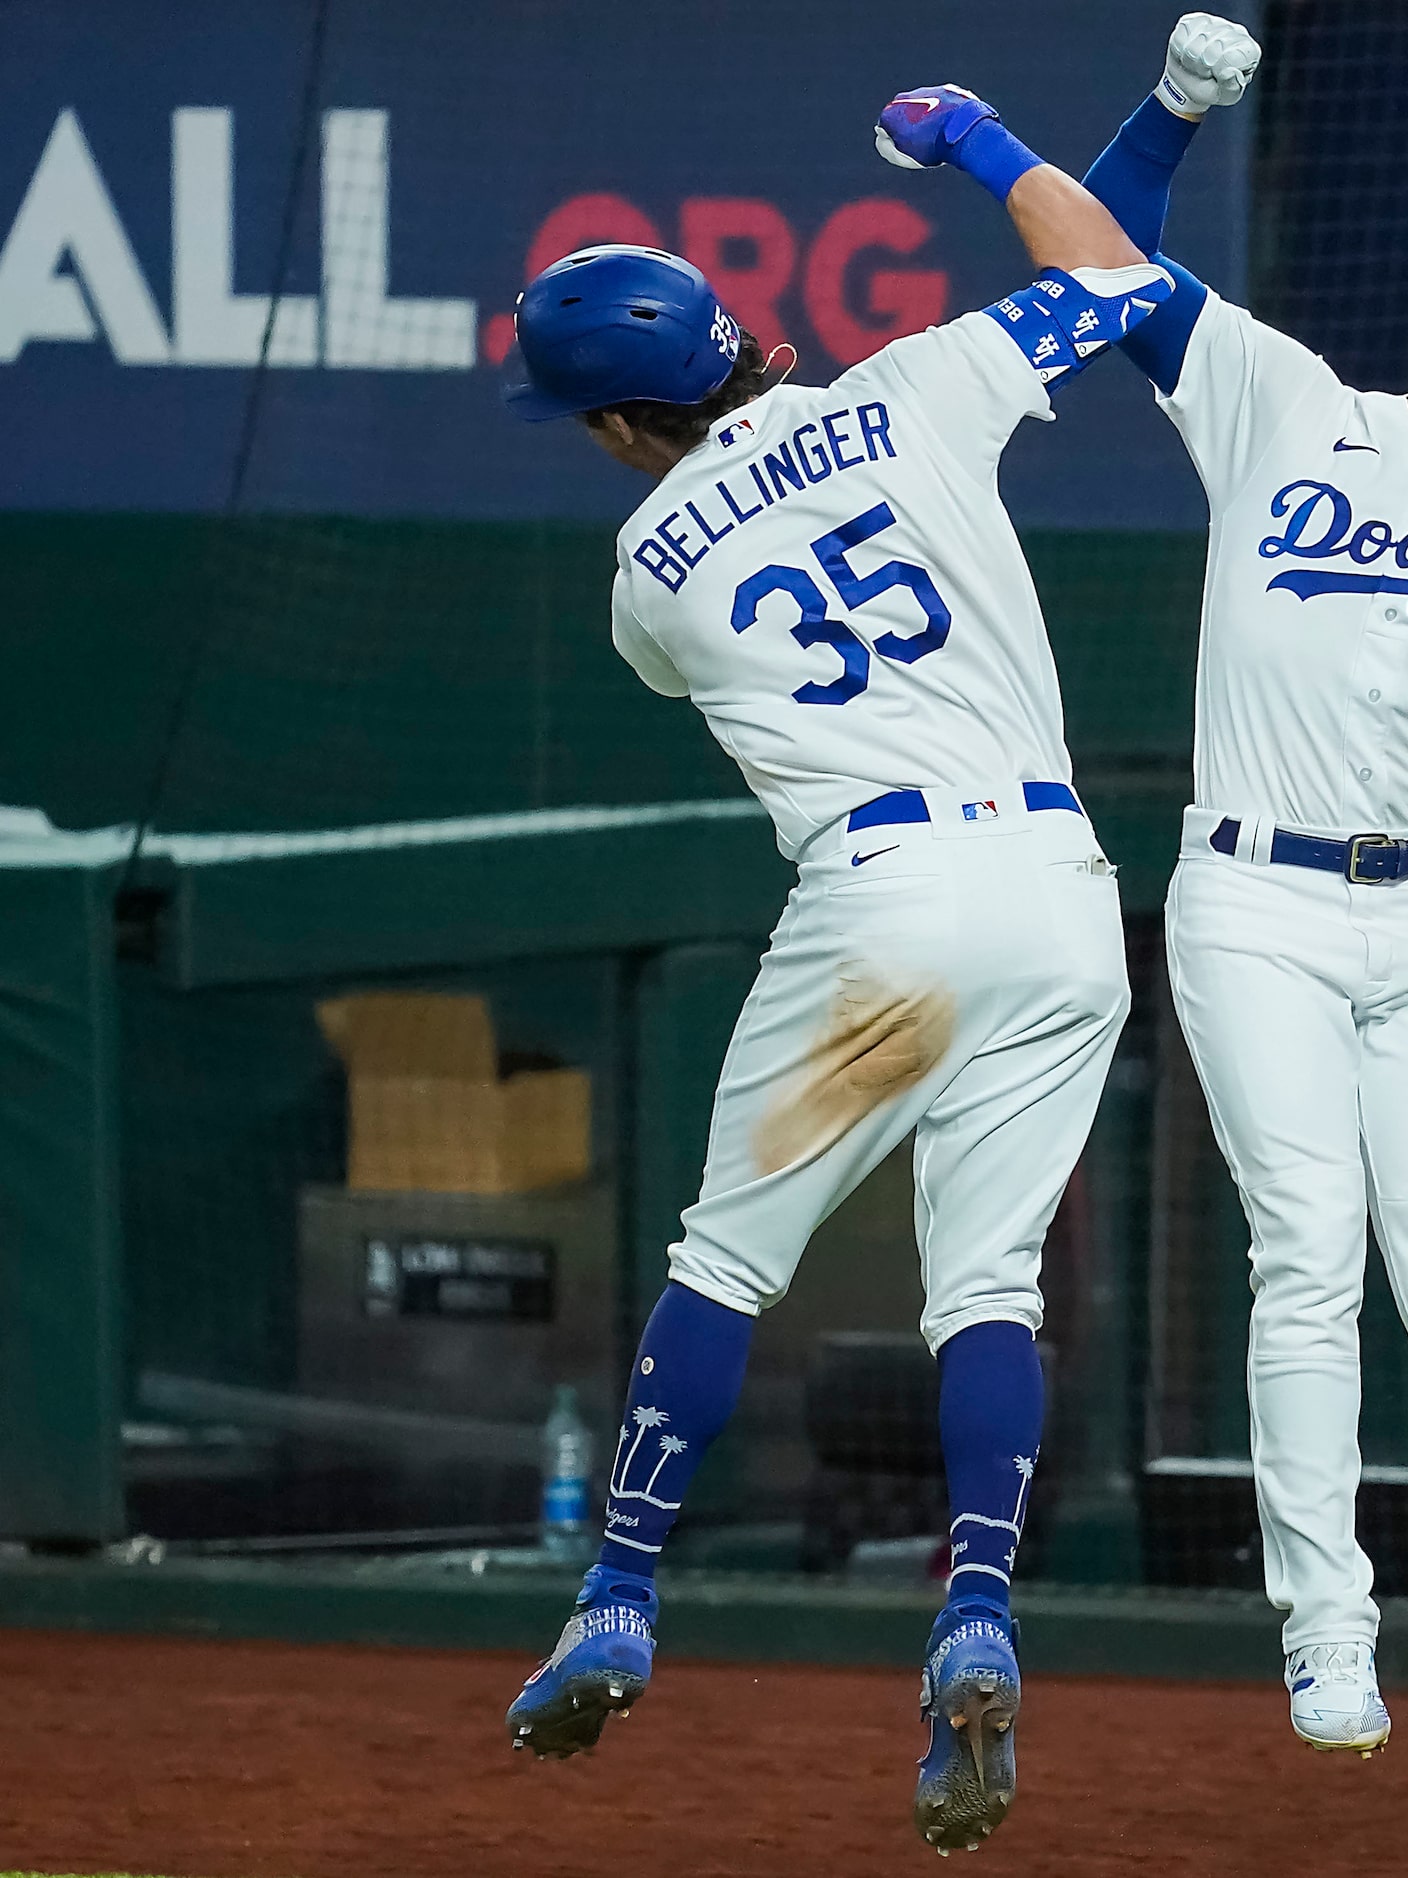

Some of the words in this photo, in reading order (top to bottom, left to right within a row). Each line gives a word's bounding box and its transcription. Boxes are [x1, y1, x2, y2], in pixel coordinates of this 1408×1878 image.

[710, 305, 732, 353] 35
[632, 401, 898, 594] BELLINGER
[730, 501, 952, 705] 35
